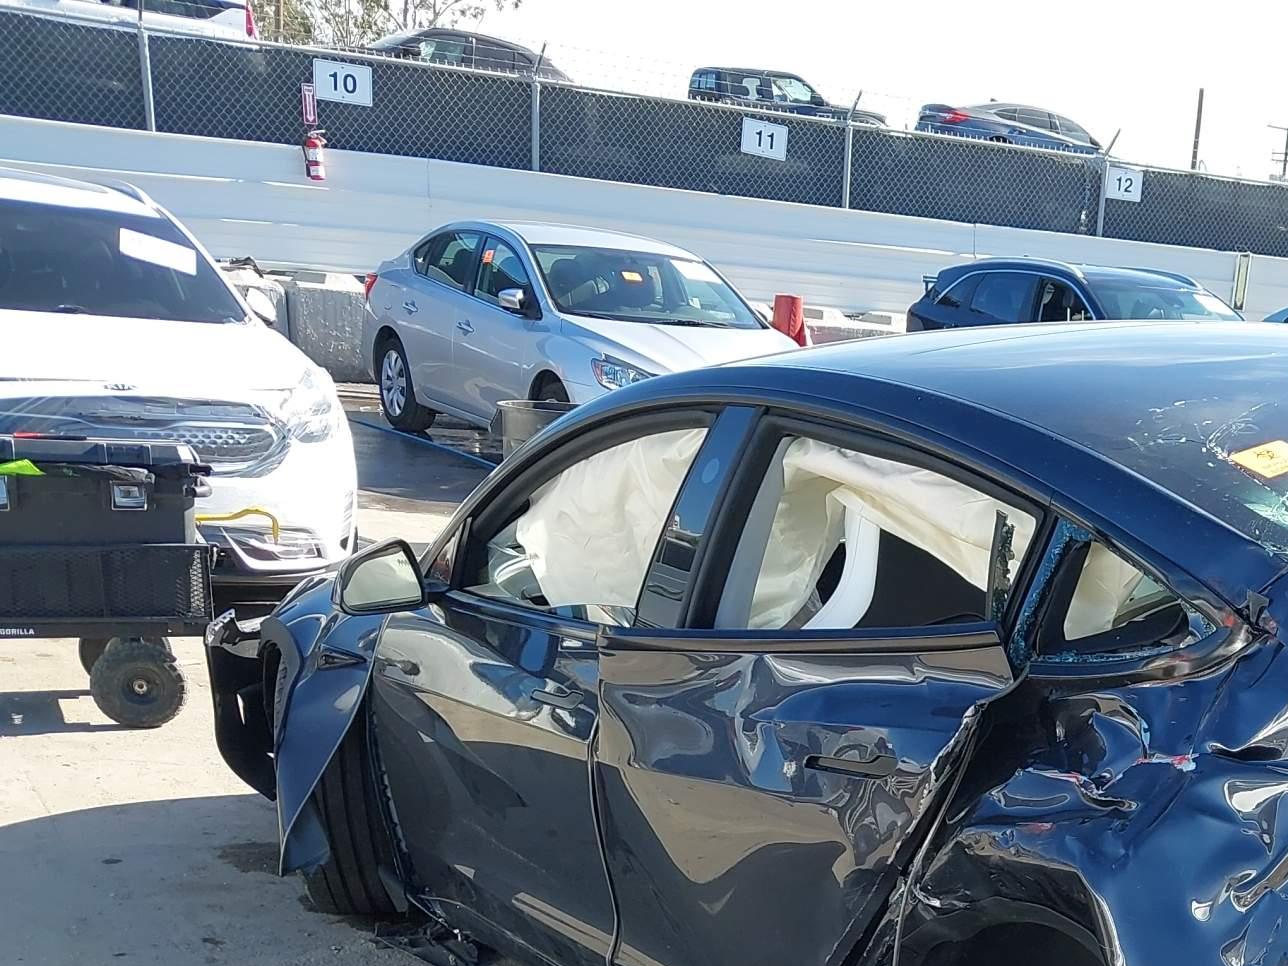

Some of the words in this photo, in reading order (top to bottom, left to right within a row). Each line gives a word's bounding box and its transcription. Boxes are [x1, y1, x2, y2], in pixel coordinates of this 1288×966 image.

[328, 71, 357, 94] 10
[755, 129, 774, 150] 11
[1116, 176, 1133, 193] 12
